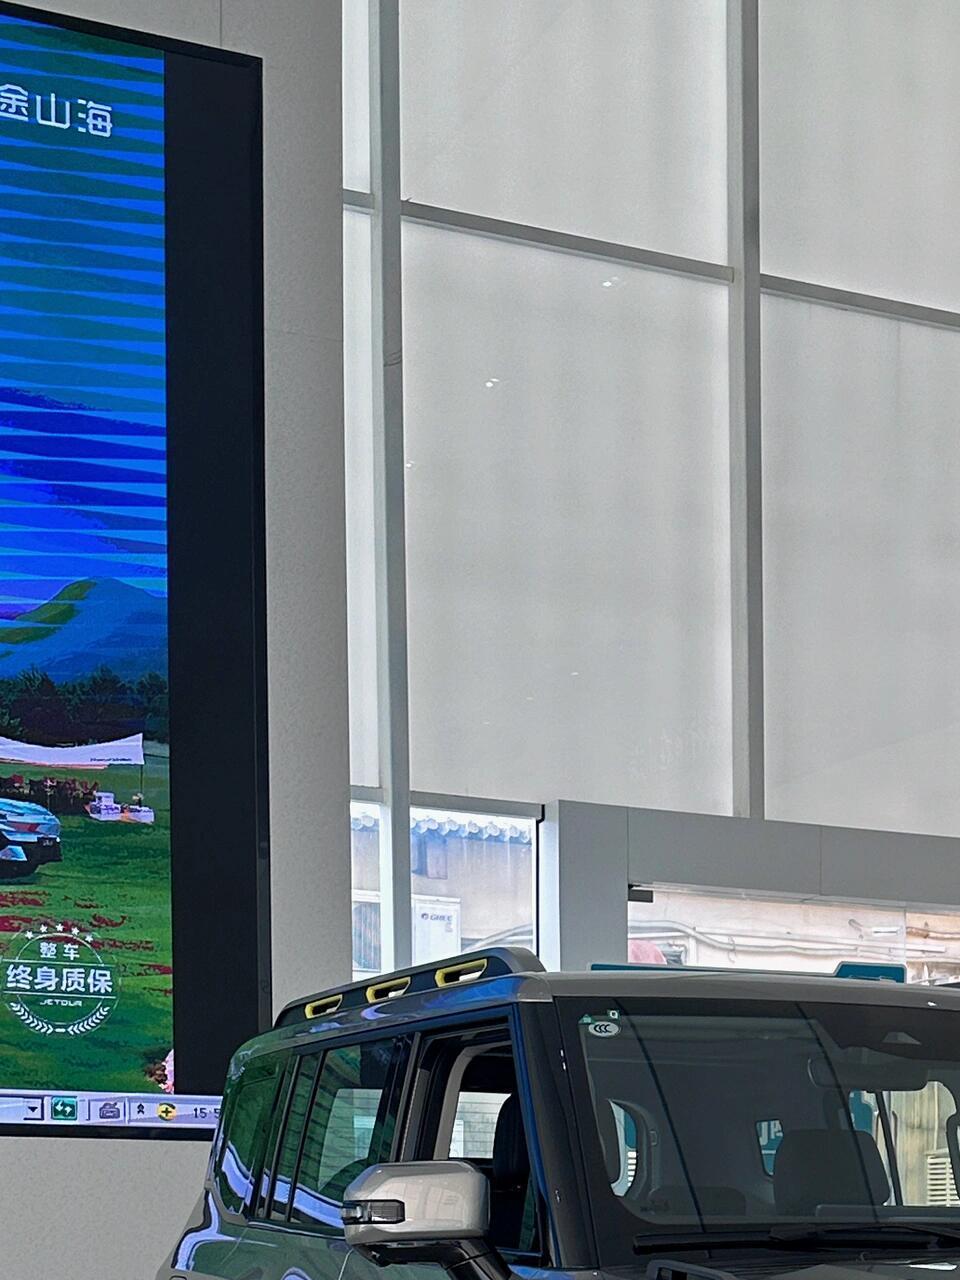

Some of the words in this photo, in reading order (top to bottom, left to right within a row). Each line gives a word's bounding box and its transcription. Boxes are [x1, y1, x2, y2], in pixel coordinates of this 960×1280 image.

[40, 942, 80, 960] 整车
[6, 964, 113, 993] 终身质保
[40, 998, 82, 1006] JETOUR
